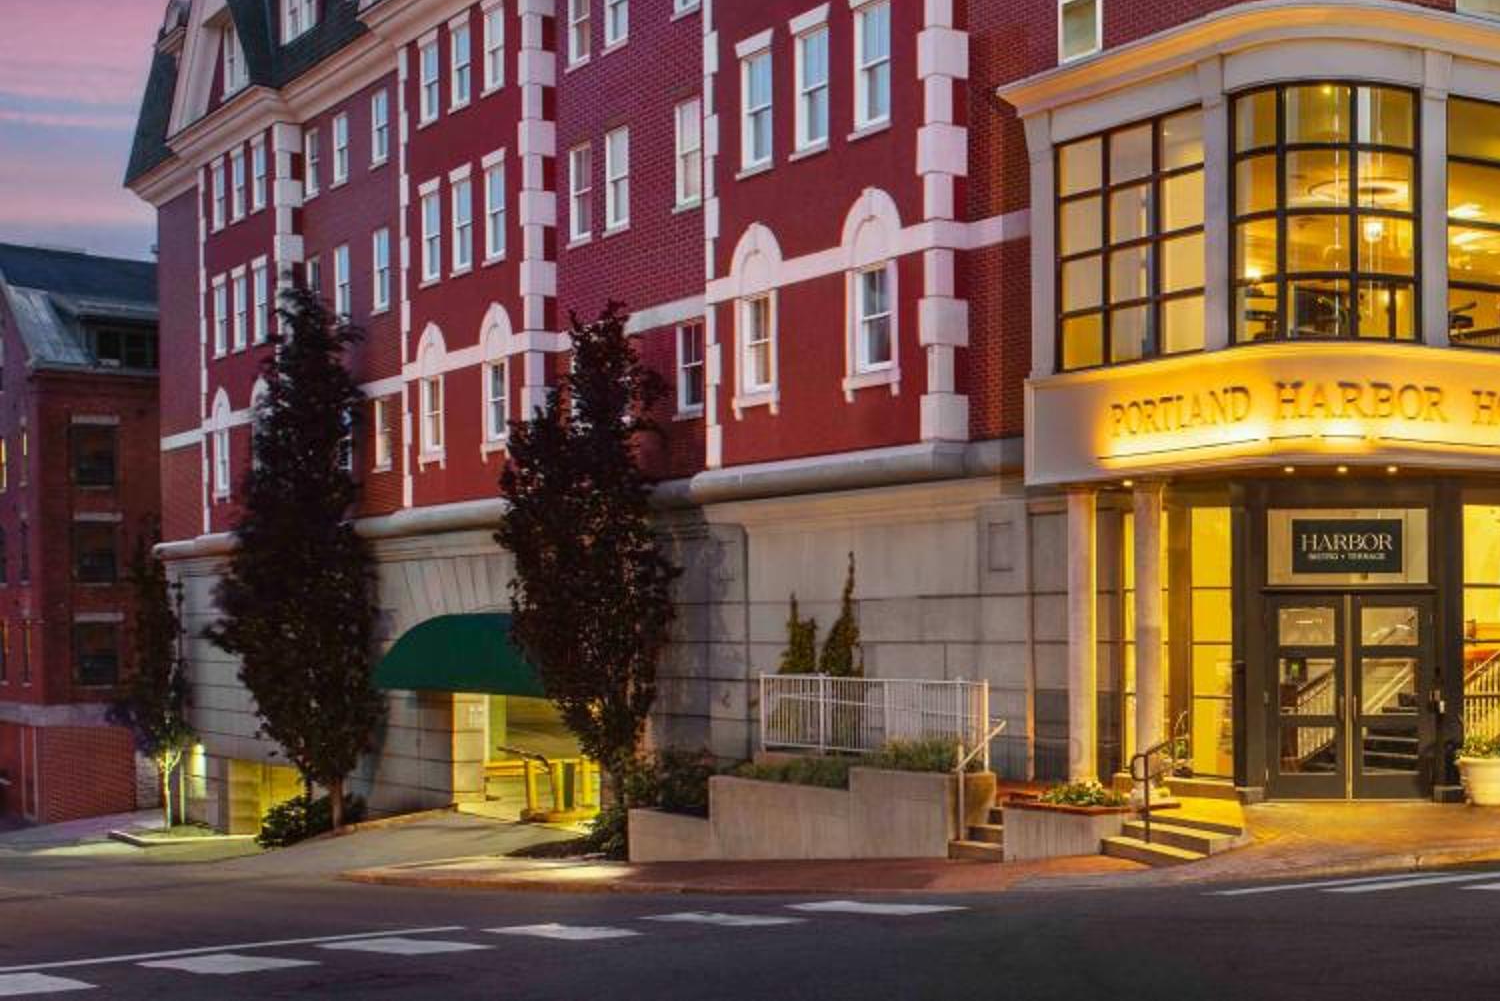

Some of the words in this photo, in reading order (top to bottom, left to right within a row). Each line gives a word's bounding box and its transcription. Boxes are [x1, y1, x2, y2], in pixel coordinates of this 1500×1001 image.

[1111, 386, 1252, 436] PORTLAND
[1274, 381, 1448, 422] HARBOR
[1301, 533, 1393, 551] HARBOR
